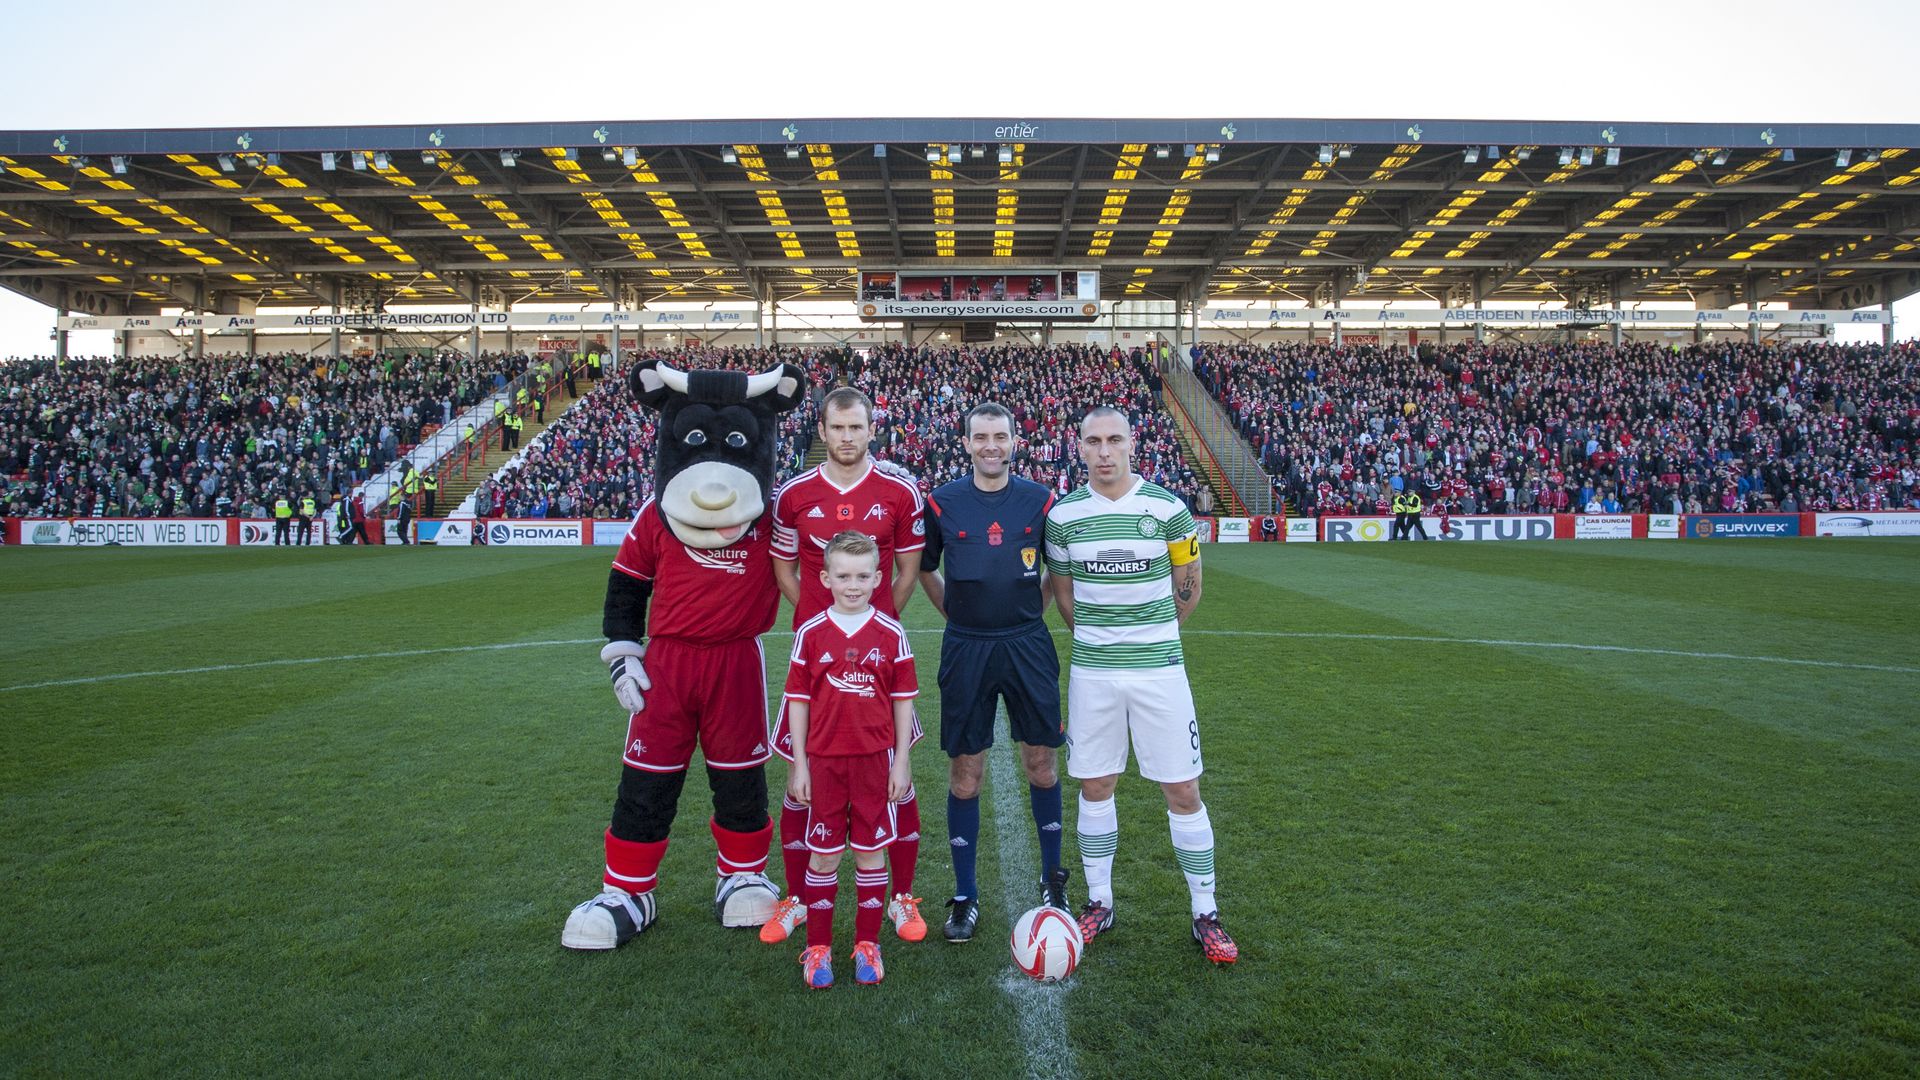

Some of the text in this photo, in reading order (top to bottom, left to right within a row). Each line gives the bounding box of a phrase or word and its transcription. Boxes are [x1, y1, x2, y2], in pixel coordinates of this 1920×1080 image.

[884, 304, 1074, 316] its-energyservices.com
[1444, 310, 1656, 321] ABERDEEN FABRICATION LTD
[294, 313, 508, 326] ABERDEEN FABRICATION LTD
[36, 525, 57, 536] AWL
[67, 523, 220, 543] ABERDEEN WEB LTD
[513, 529, 578, 538] ROMAR
[1716, 524, 1785, 532] SURVIVEX
[1189, 536, 1198, 556] C
[707, 549, 748, 559] Saltire
[1087, 560, 1147, 574] MAGNERS
[843, 671, 875, 683] Saltire
[1189, 720, 1199, 751] 8
